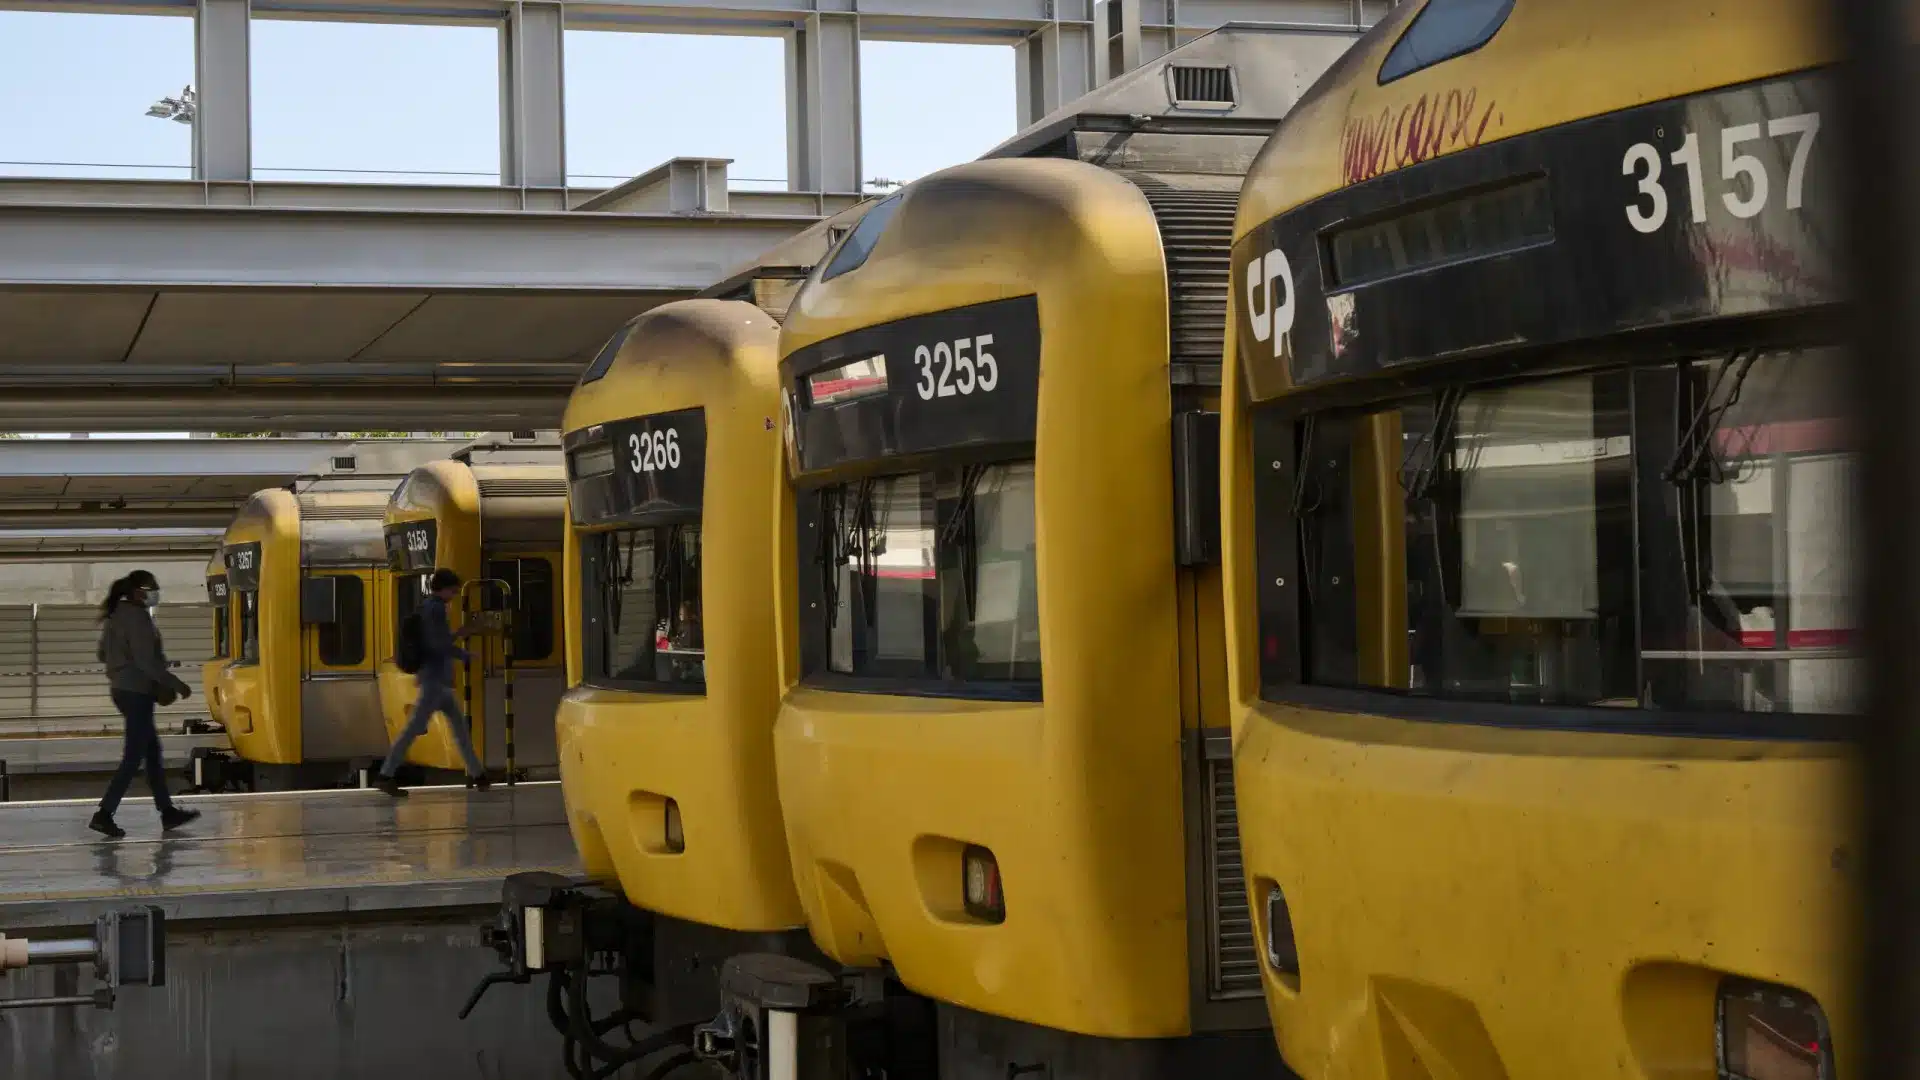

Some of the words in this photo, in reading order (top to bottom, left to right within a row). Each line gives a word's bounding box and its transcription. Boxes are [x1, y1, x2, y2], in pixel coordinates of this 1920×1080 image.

[1622, 112, 1820, 233] 3157
[914, 334, 999, 400] 3255
[629, 428, 681, 474] 3266
[237, 550, 253, 570] 3267
[407, 529, 429, 551] 3158
